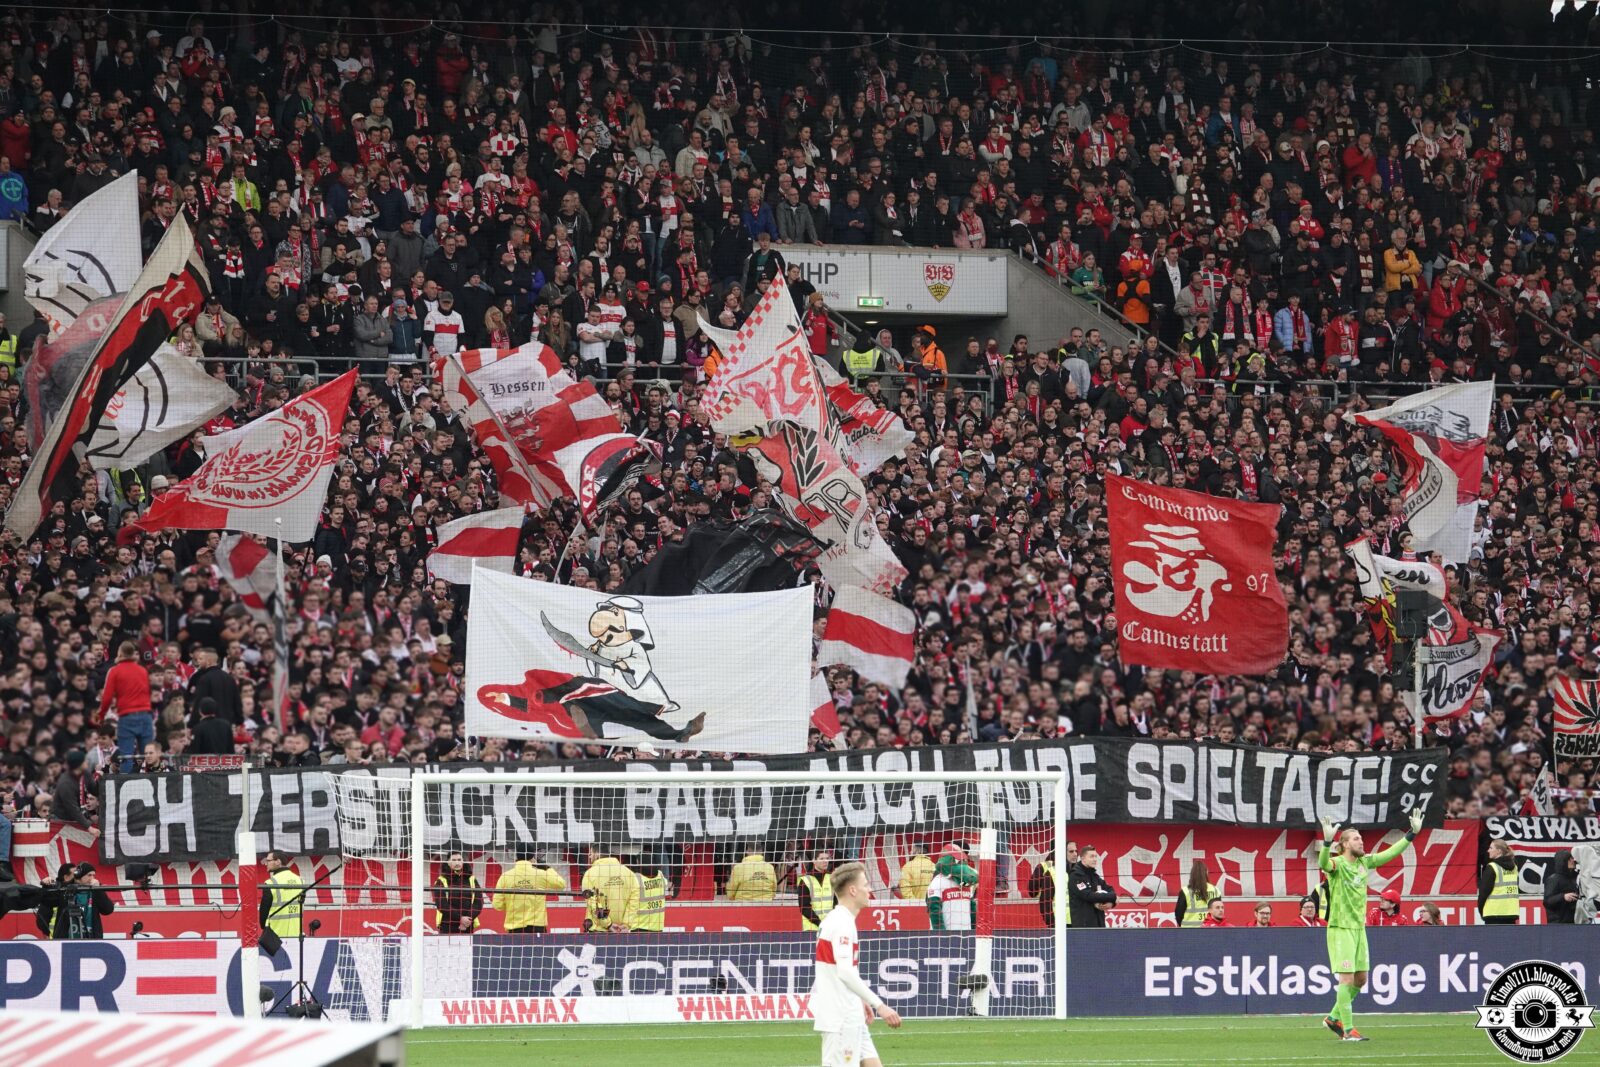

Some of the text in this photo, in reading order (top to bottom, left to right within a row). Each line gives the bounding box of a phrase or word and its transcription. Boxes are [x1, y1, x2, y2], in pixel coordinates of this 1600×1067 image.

[490, 380, 545, 398] Hessen
[1121, 485, 1230, 522] Commando
[1245, 573, 1269, 593] 97
[1122, 620, 1229, 653] Cannstatt
[187, 755, 246, 767] JEDER
[1403, 763, 1435, 785] CC
[105, 742, 1393, 860] ICH ZERSTÜCKEL BALD AUCH EURE SPIELTAGE!
[1401, 791, 1434, 815] 97
[872, 908, 900, 931] 35
[1144, 955, 1426, 1005] Erstklasge
[442, 998, 579, 1025] WINAMAX
[677, 995, 814, 1021] WINAMAX
